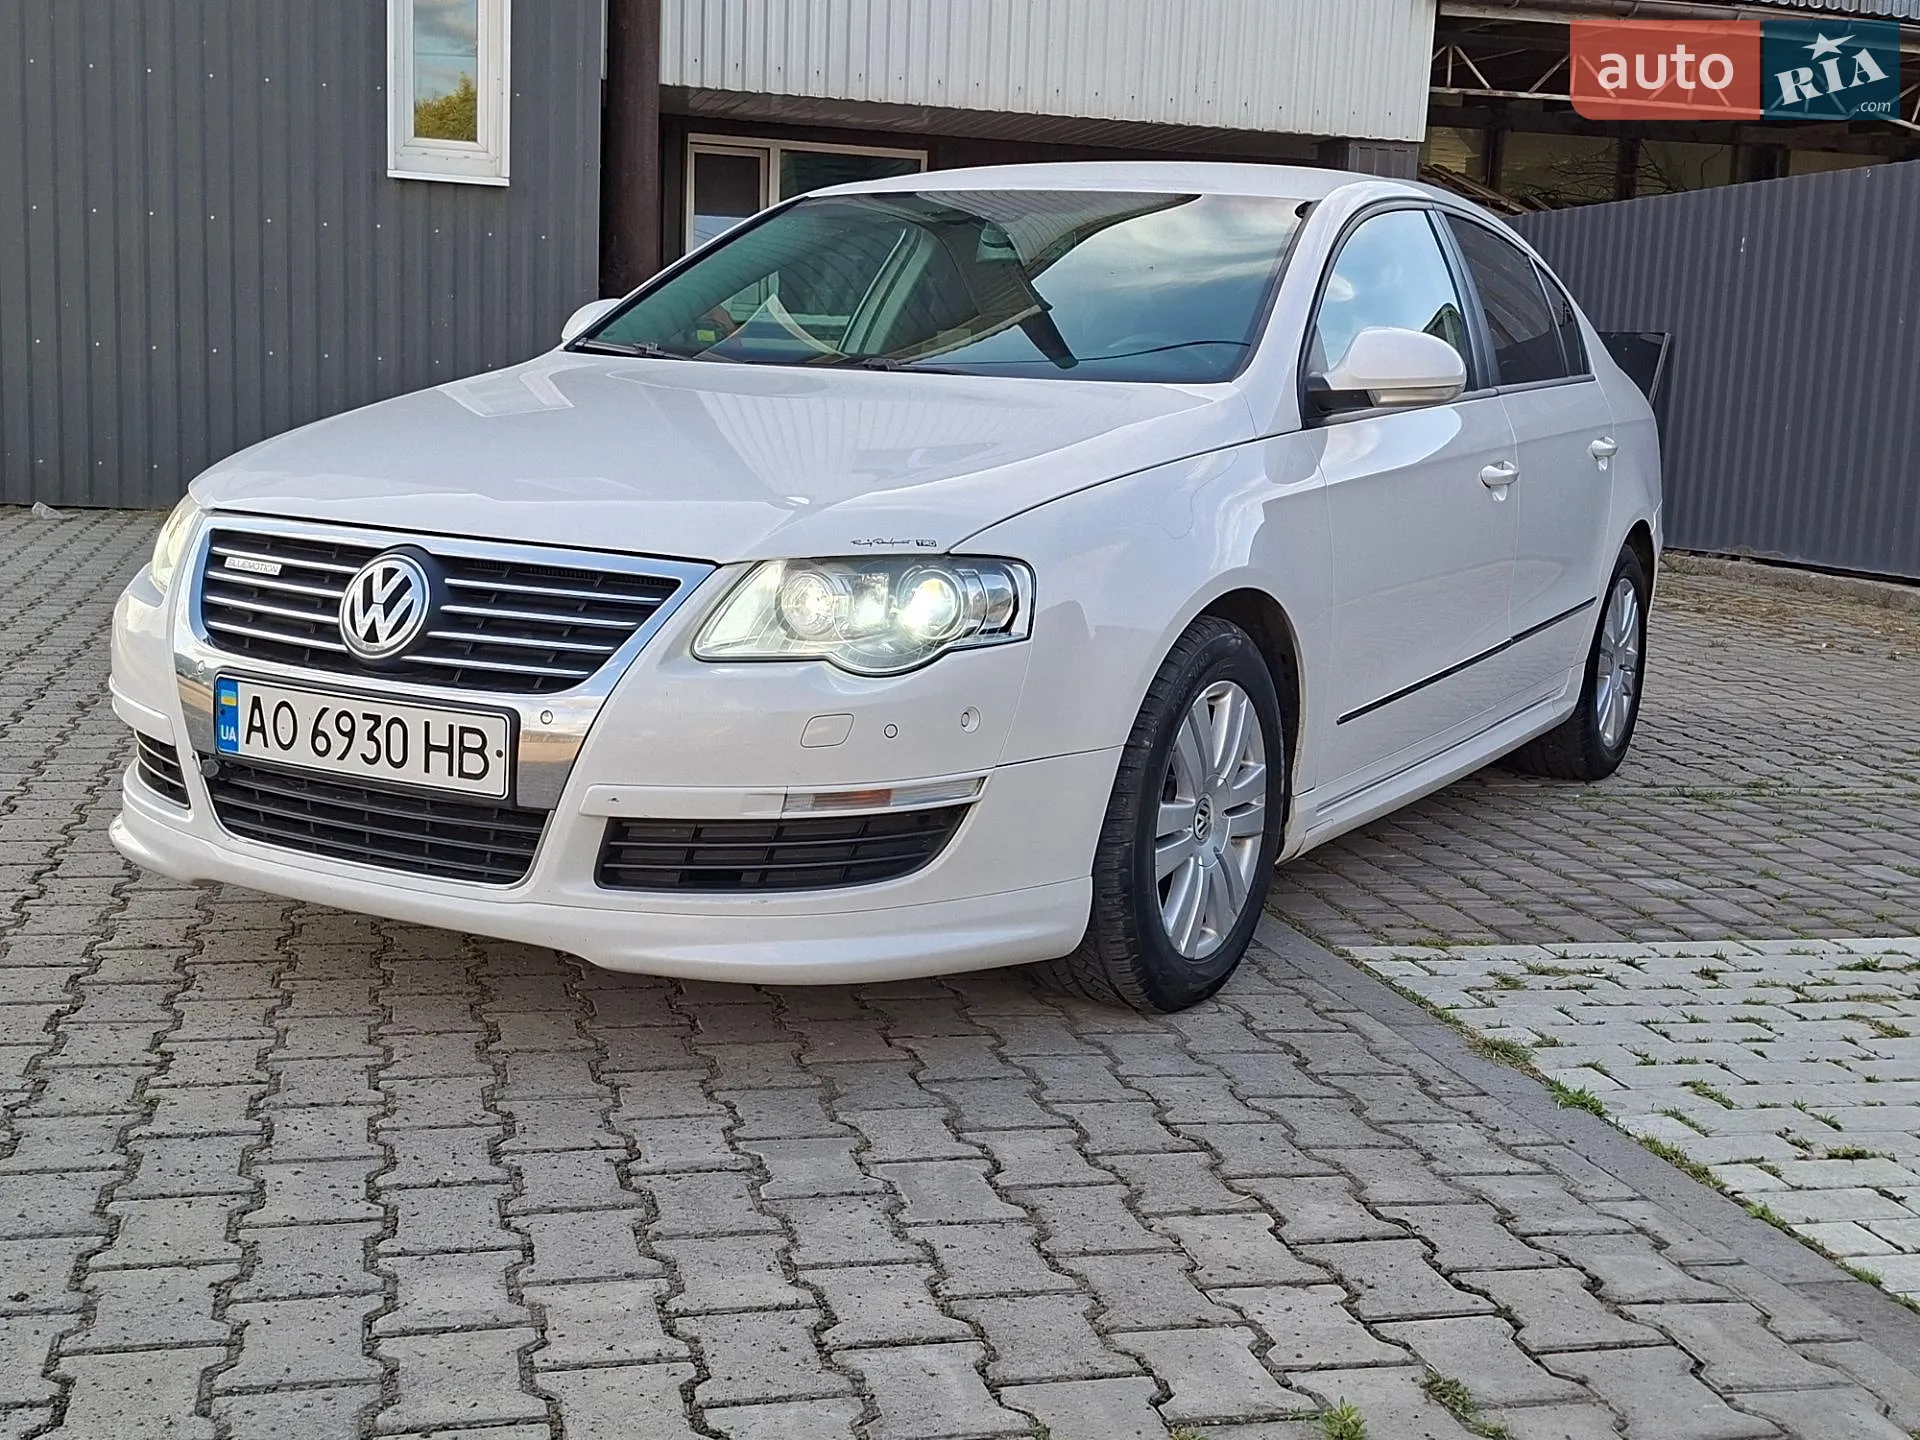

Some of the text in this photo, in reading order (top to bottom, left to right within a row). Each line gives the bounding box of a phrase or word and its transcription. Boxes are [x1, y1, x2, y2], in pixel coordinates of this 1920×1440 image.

[220, 724, 237, 742] UA
[245, 695, 490, 781] AO 6930 HB
